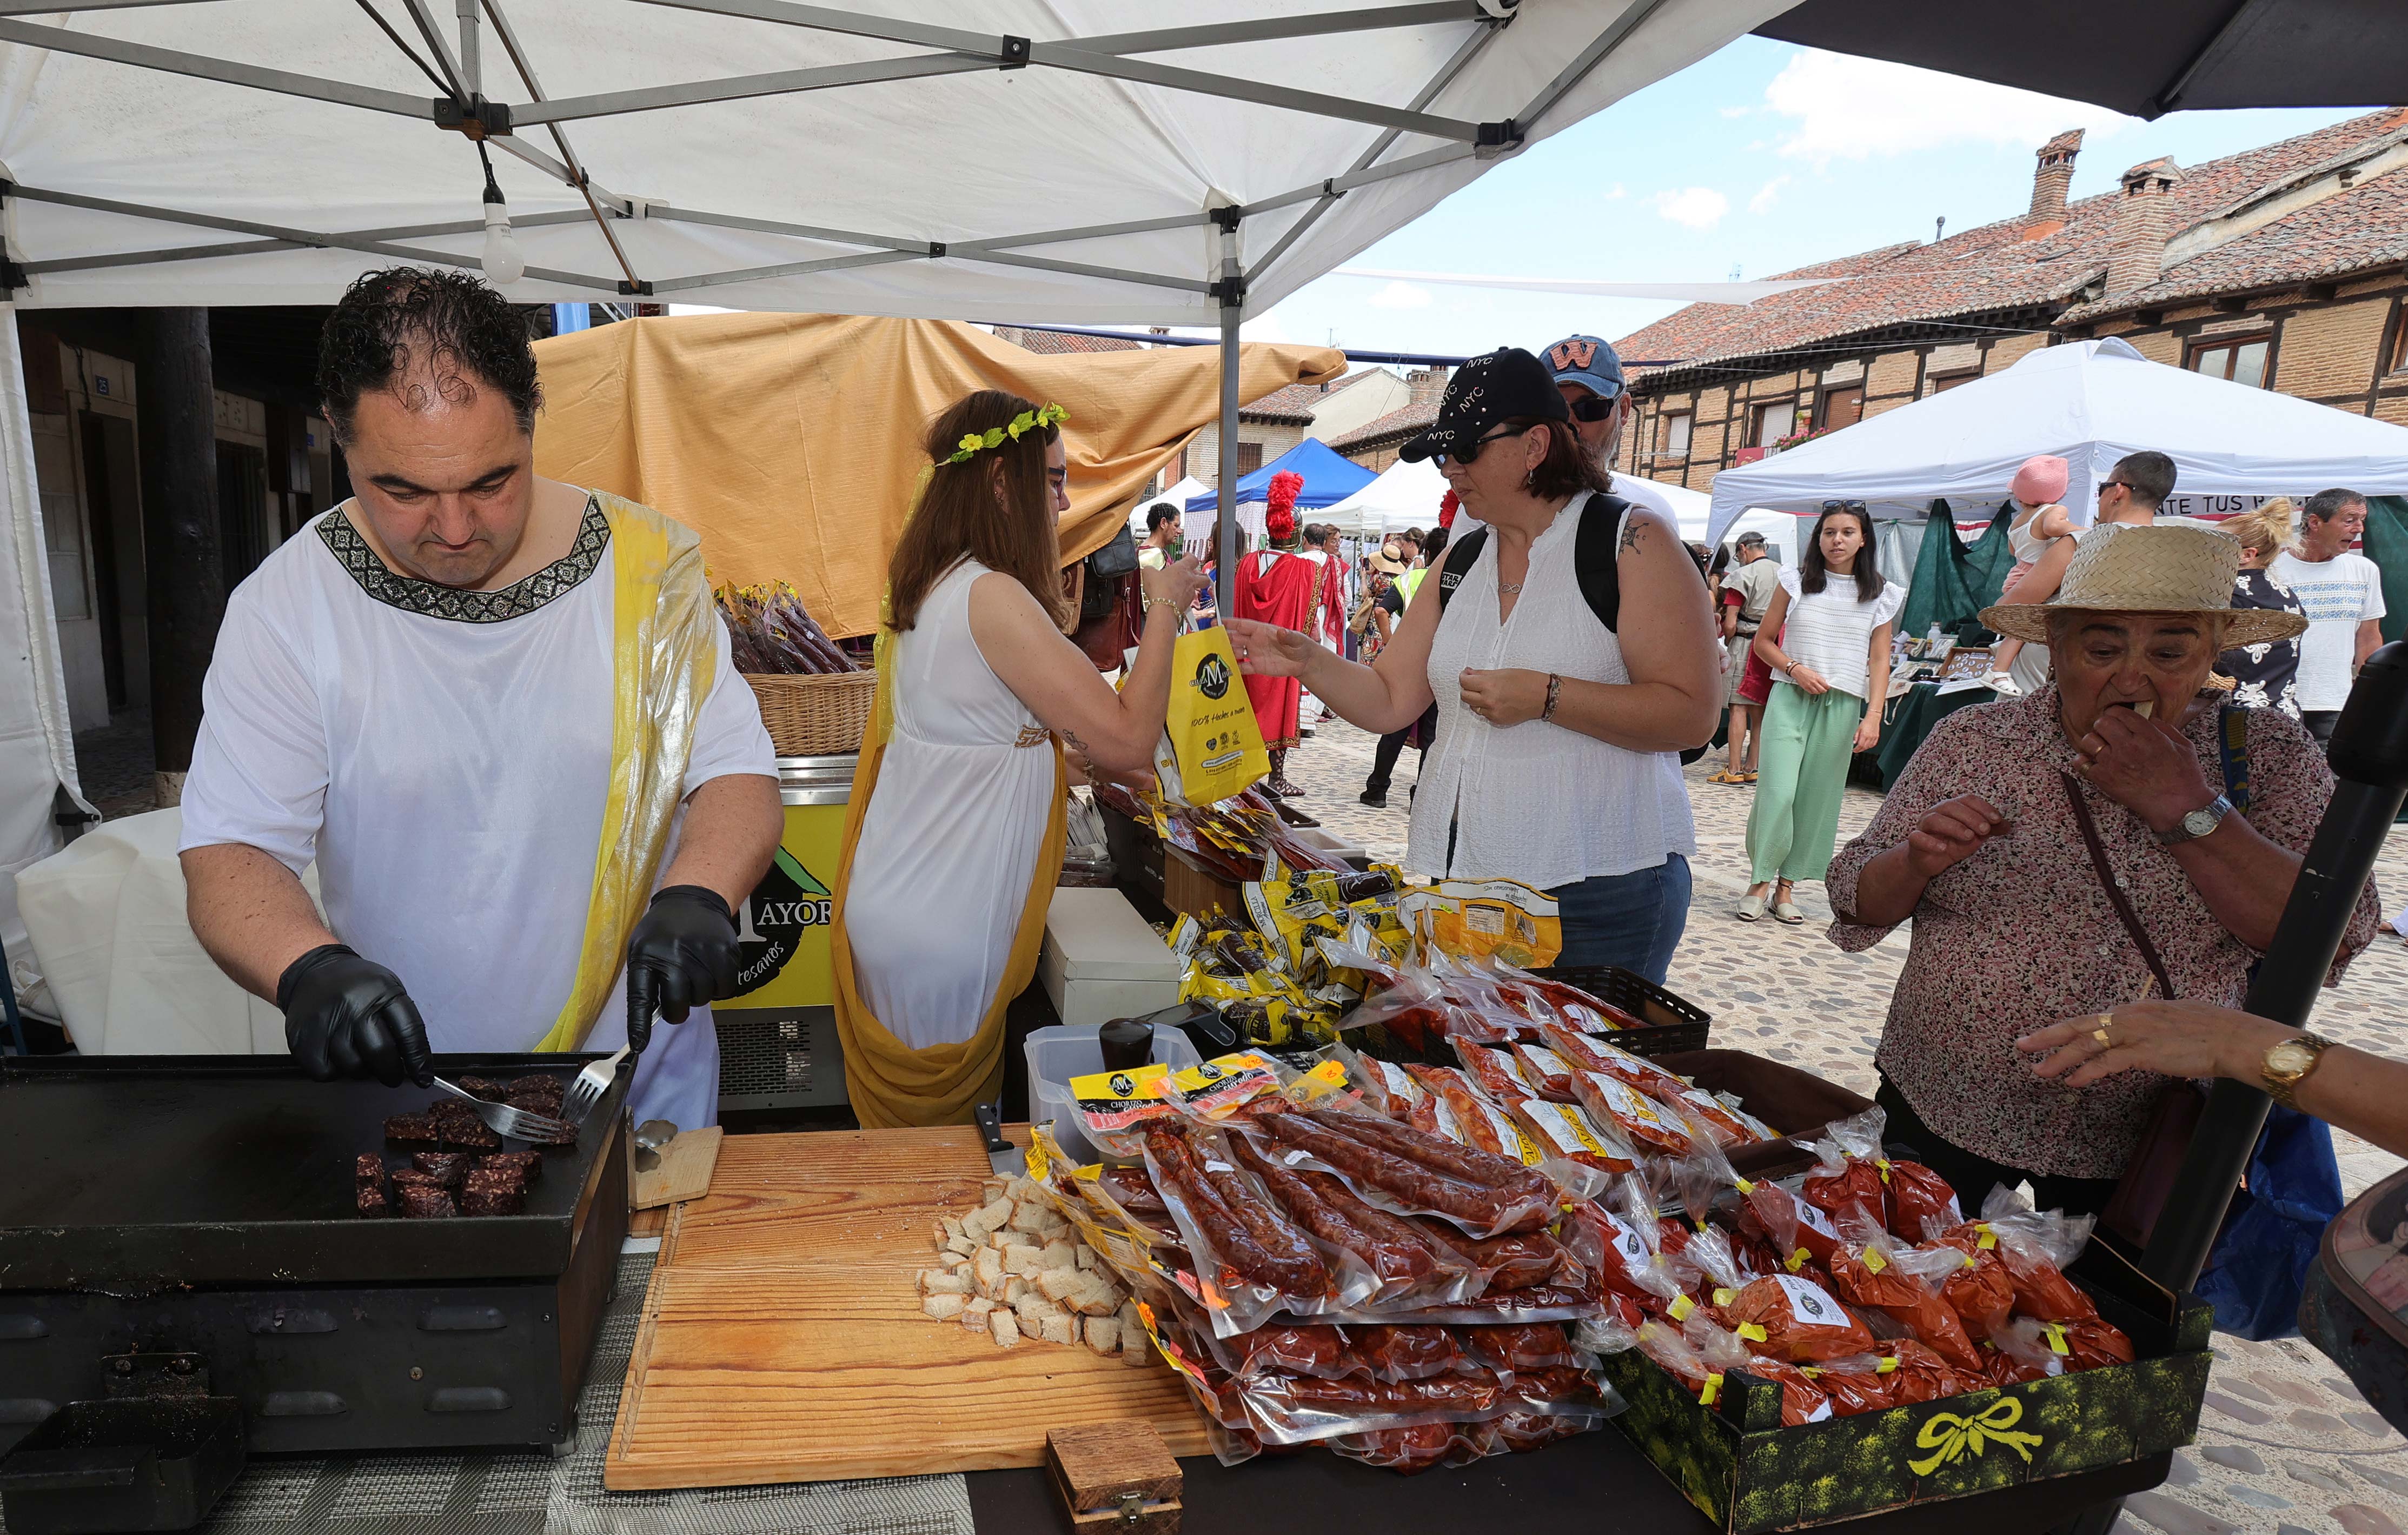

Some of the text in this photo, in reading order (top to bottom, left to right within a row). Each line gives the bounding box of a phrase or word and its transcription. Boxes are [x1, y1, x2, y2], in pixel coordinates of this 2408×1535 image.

[1466, 356, 1493, 369] NYC
[1549, 339, 1598, 371] W
[1439, 384, 1457, 408] NYC
[1460, 386, 1484, 413] NYC
[1427, 429, 1455, 441] NYC
[2203, 495, 2243, 513] TUS
[1191, 714, 1209, 727] 100%
[1250, 896, 1266, 927] MORCILLA
[1209, 1075, 1237, 1092] CHORIZO
[1110, 1100, 1143, 1108] CHORIZO
[1123, 1099, 1160, 1112] curado
